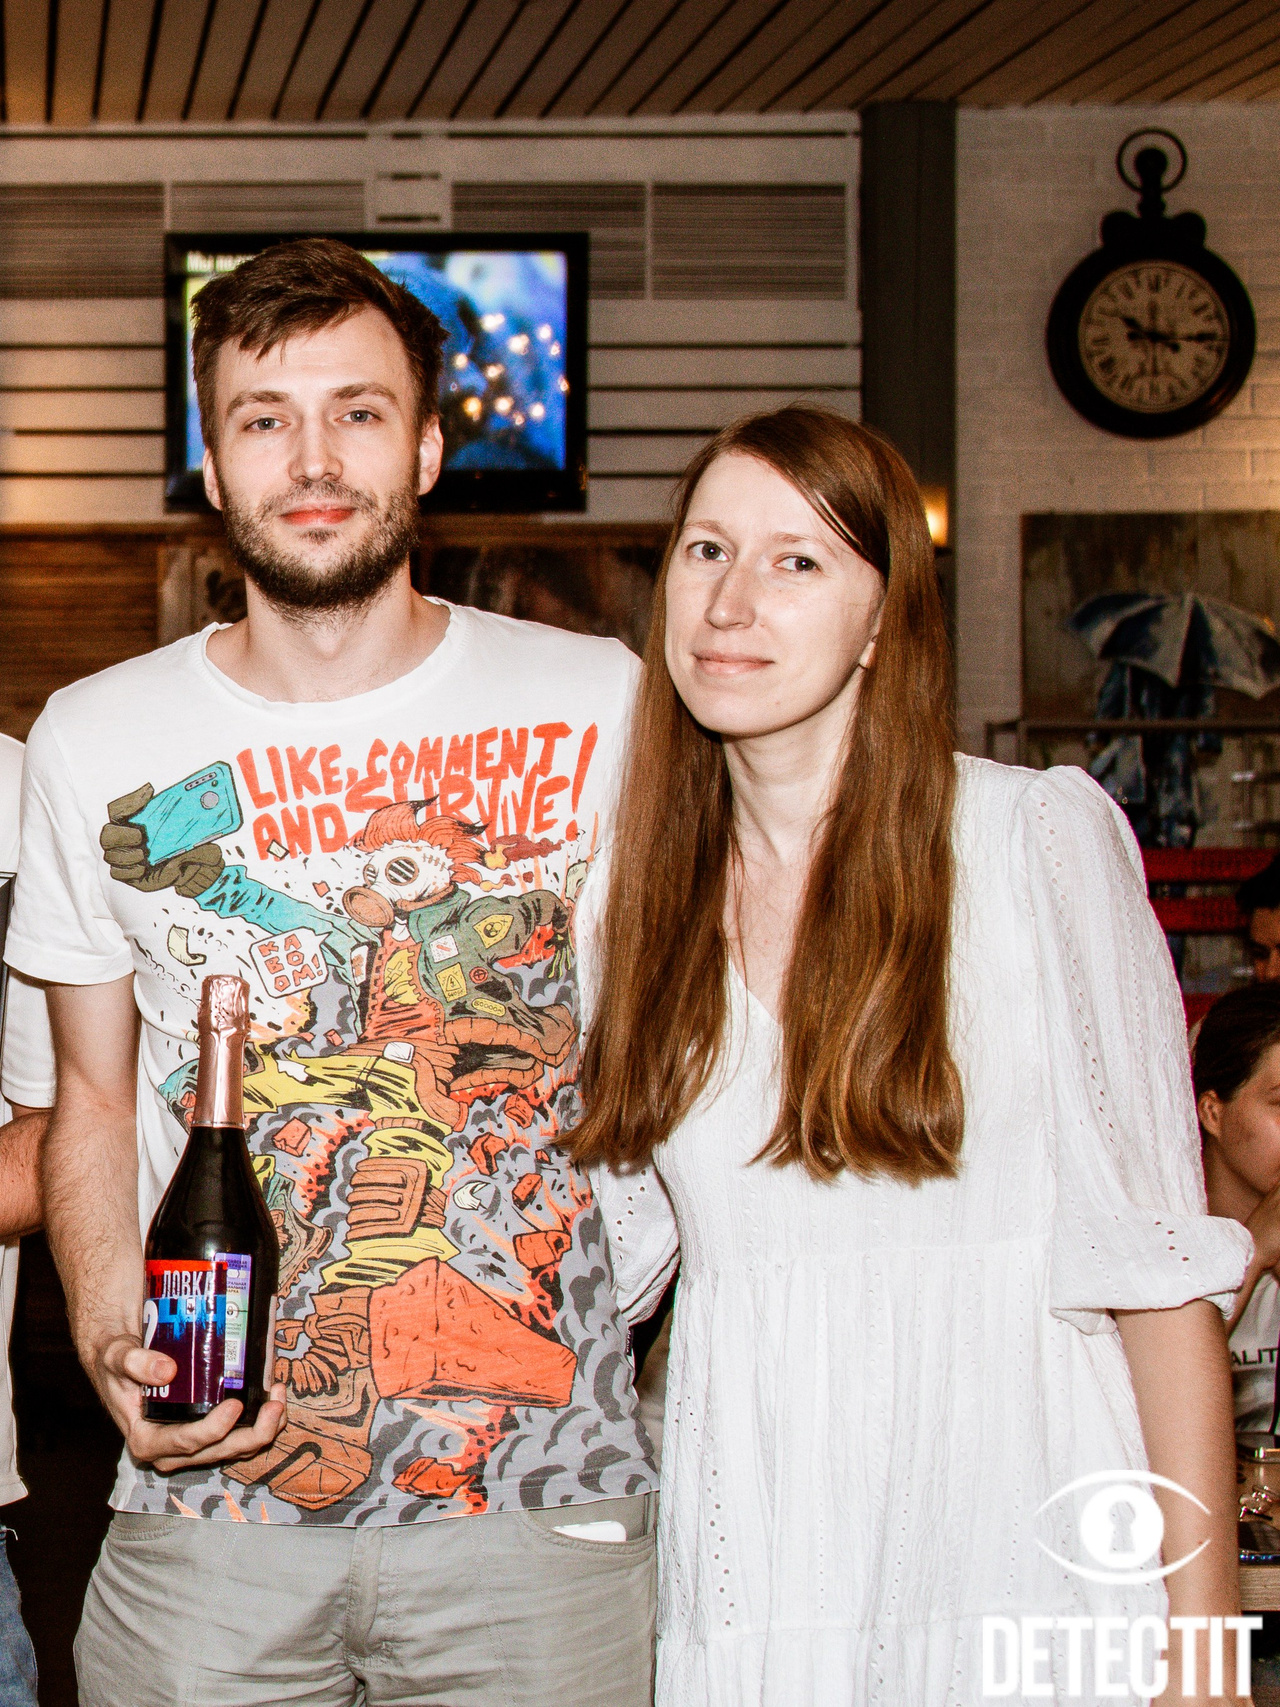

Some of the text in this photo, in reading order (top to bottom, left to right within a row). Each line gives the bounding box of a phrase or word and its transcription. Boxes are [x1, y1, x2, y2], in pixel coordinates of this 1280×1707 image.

[236, 721, 573, 810] LIKE, COMMENT
[252, 802, 349, 861] AND
